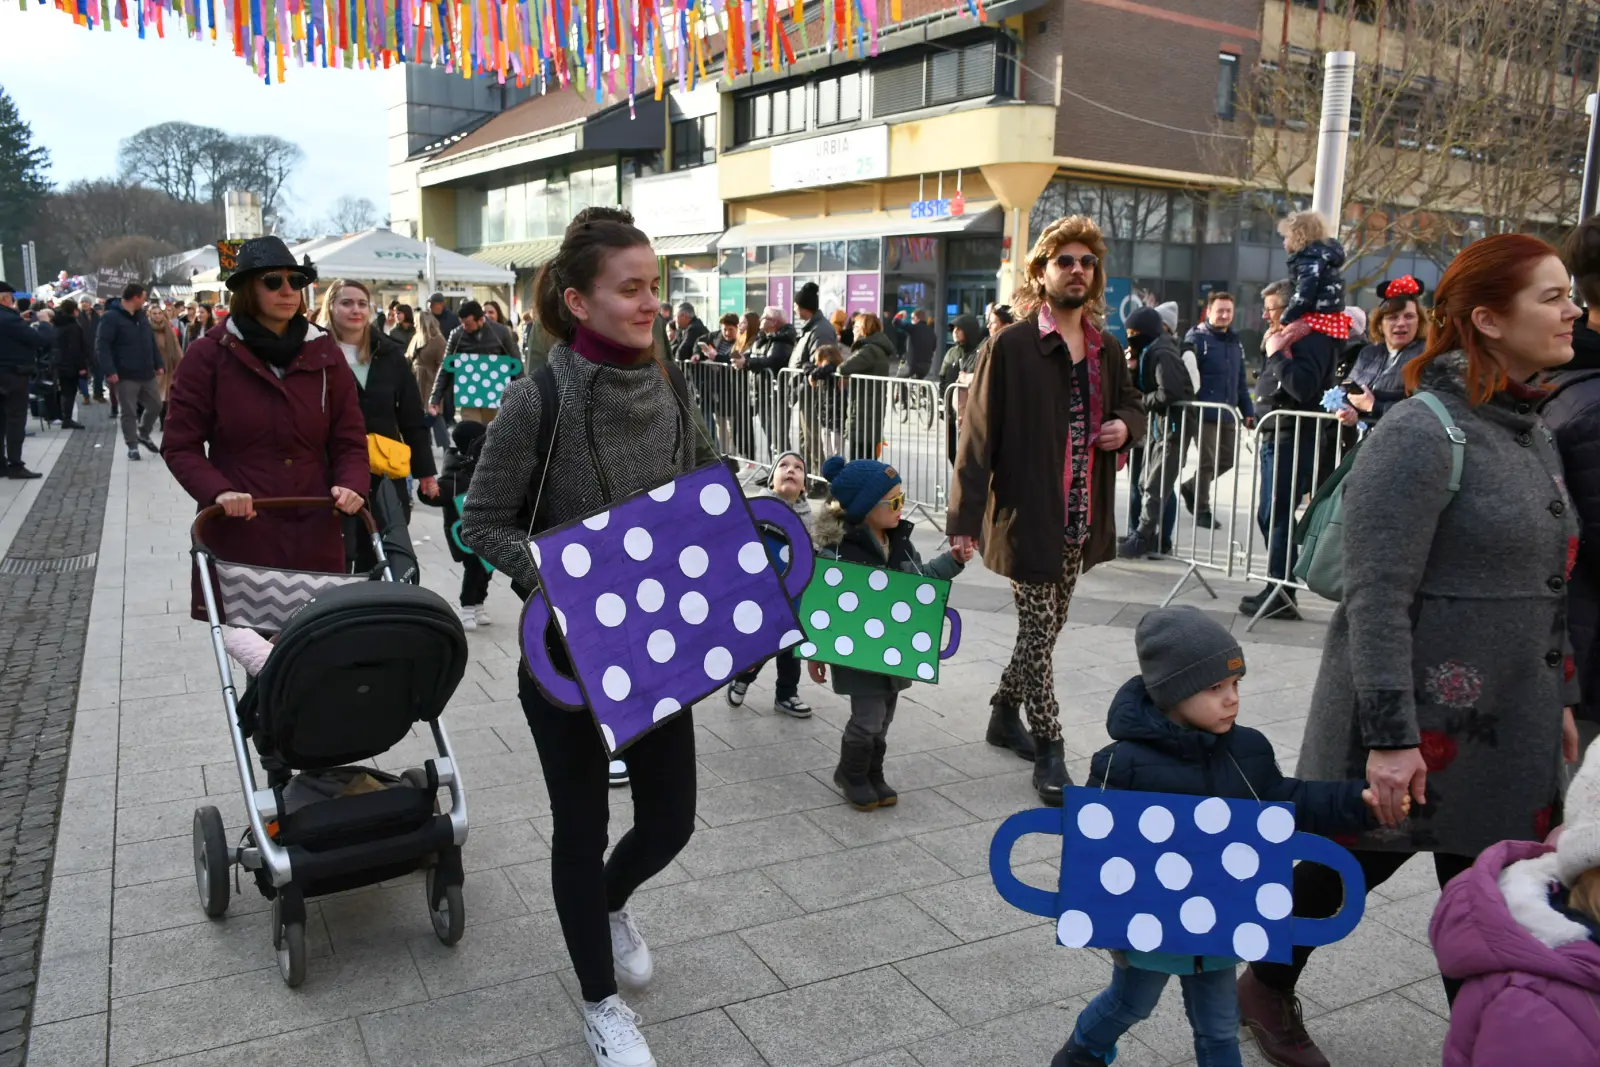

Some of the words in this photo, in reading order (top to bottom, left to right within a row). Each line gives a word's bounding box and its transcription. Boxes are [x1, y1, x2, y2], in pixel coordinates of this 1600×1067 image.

[816, 136, 849, 157] URBIA
[855, 156, 875, 175] 25
[910, 198, 949, 219] ERSTE
